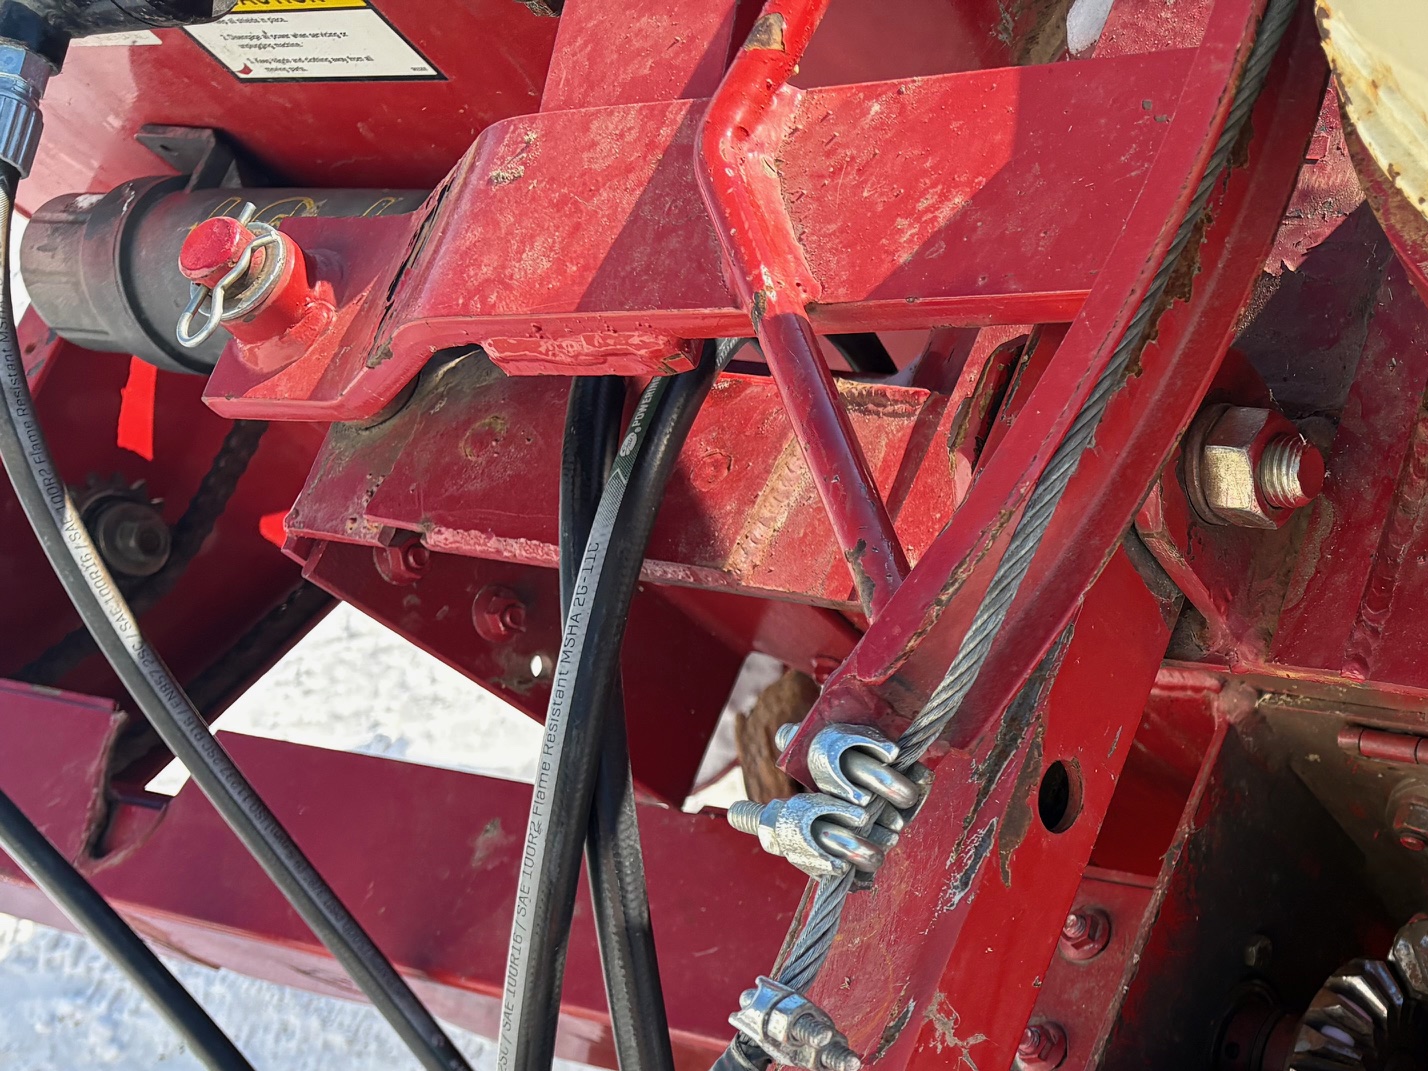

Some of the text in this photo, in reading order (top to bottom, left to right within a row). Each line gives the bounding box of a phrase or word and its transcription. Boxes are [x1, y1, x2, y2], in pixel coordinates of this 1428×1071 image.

[561, 612, 582, 664] MSHA
[541, 669, 570, 757] Resistant
[532, 760, 551, 817] Flame
[523, 820, 544, 879] 100R2
[516, 884, 531, 918] SAE
[505, 933, 523, 997] 100R16
[502, 1002, 515, 1037] SAE
